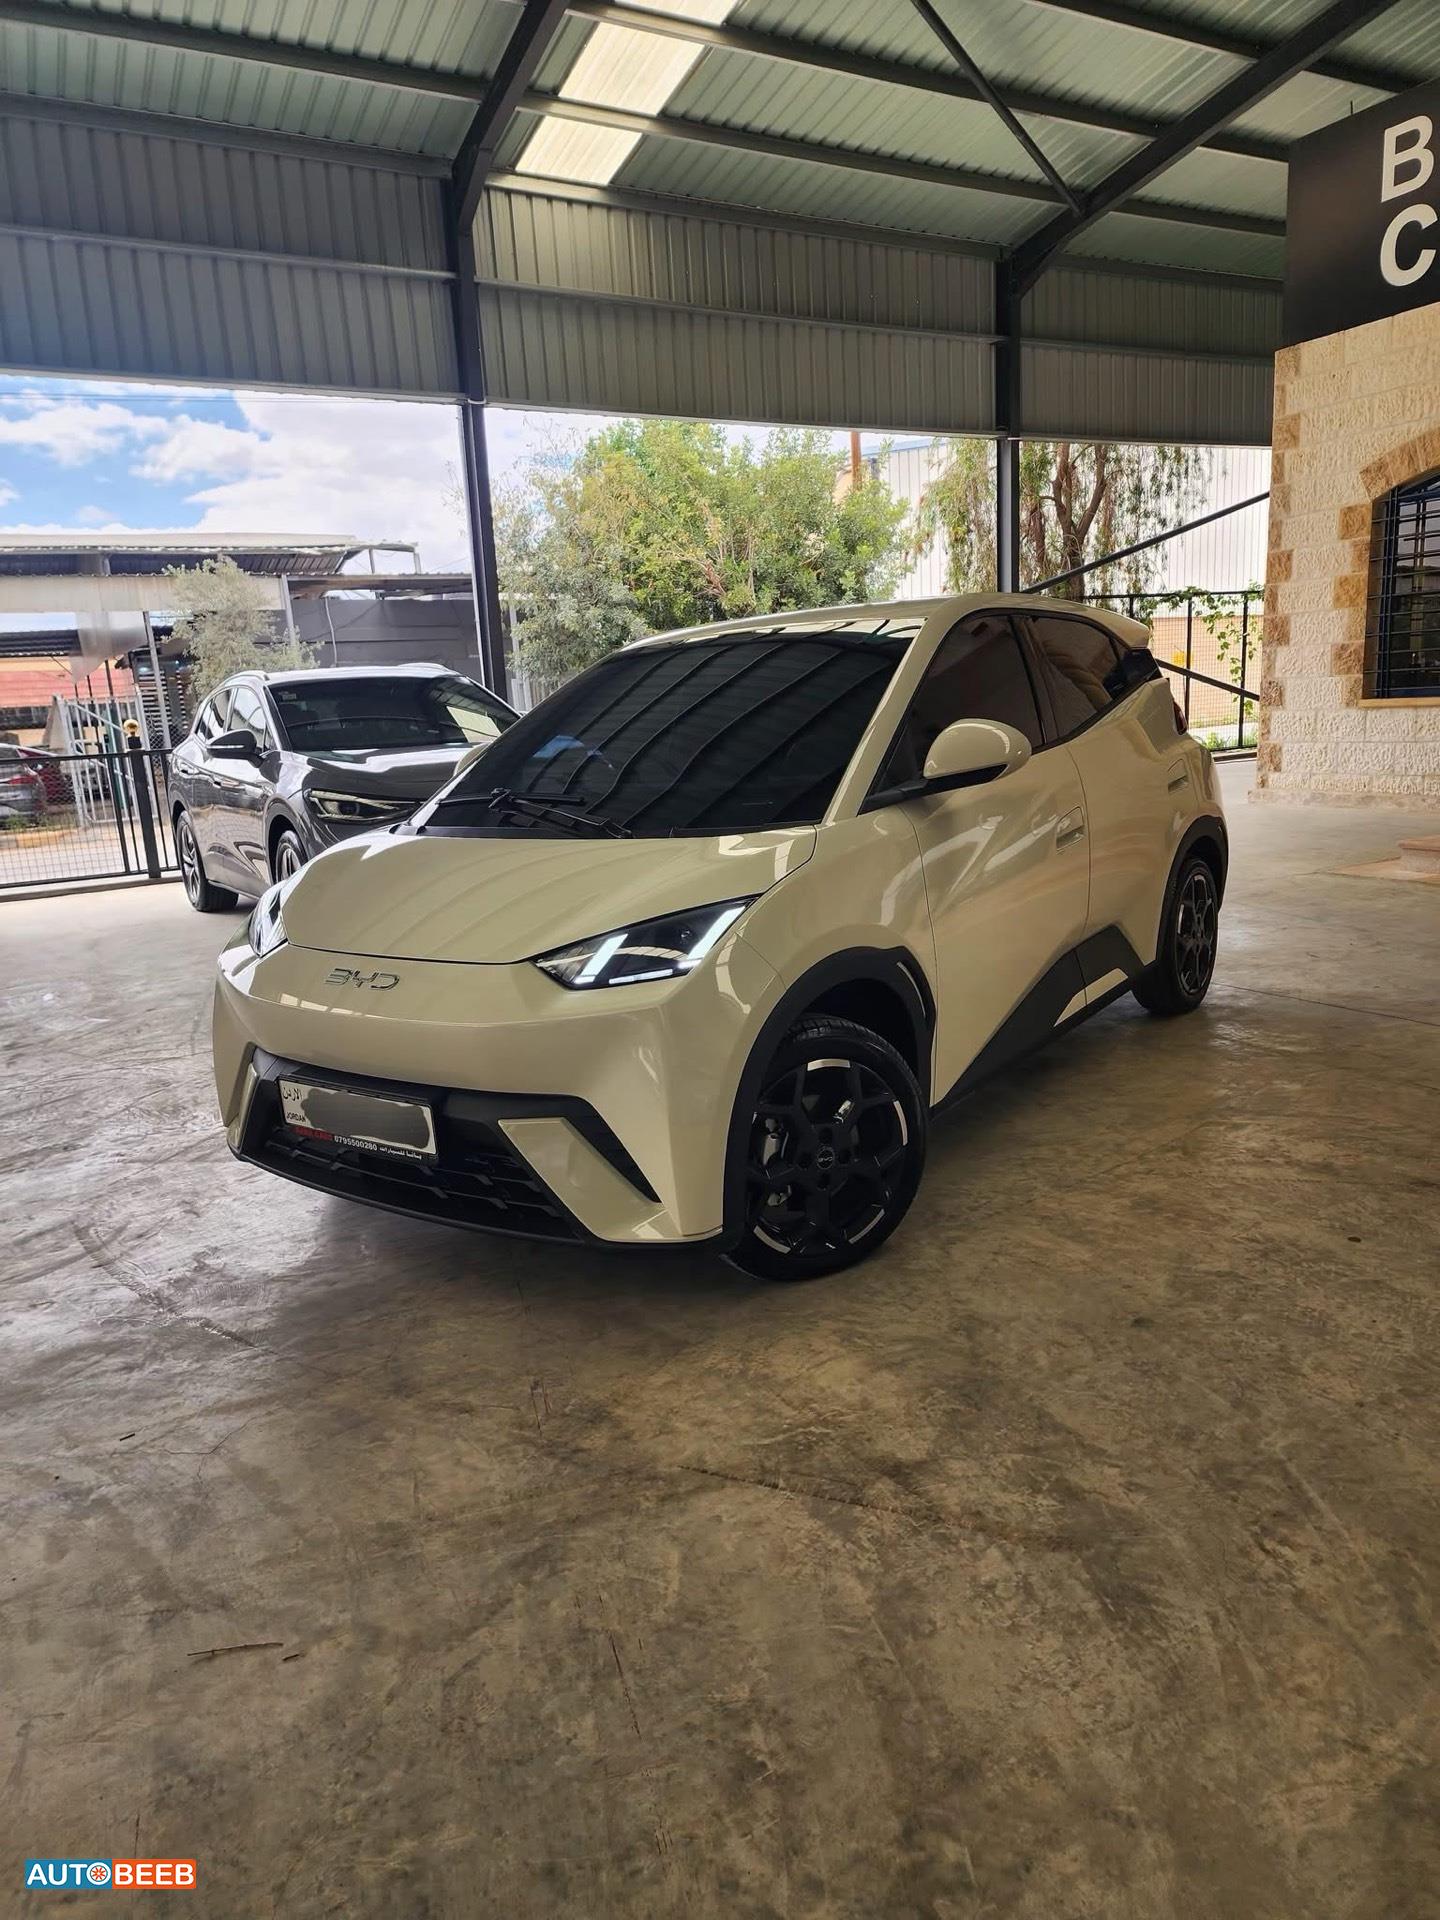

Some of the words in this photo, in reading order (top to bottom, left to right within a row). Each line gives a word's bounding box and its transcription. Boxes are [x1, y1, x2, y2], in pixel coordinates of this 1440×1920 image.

[1381, 115, 1435, 203] B
[1380, 203, 1438, 287] C
[325, 968, 400, 990] BYD
